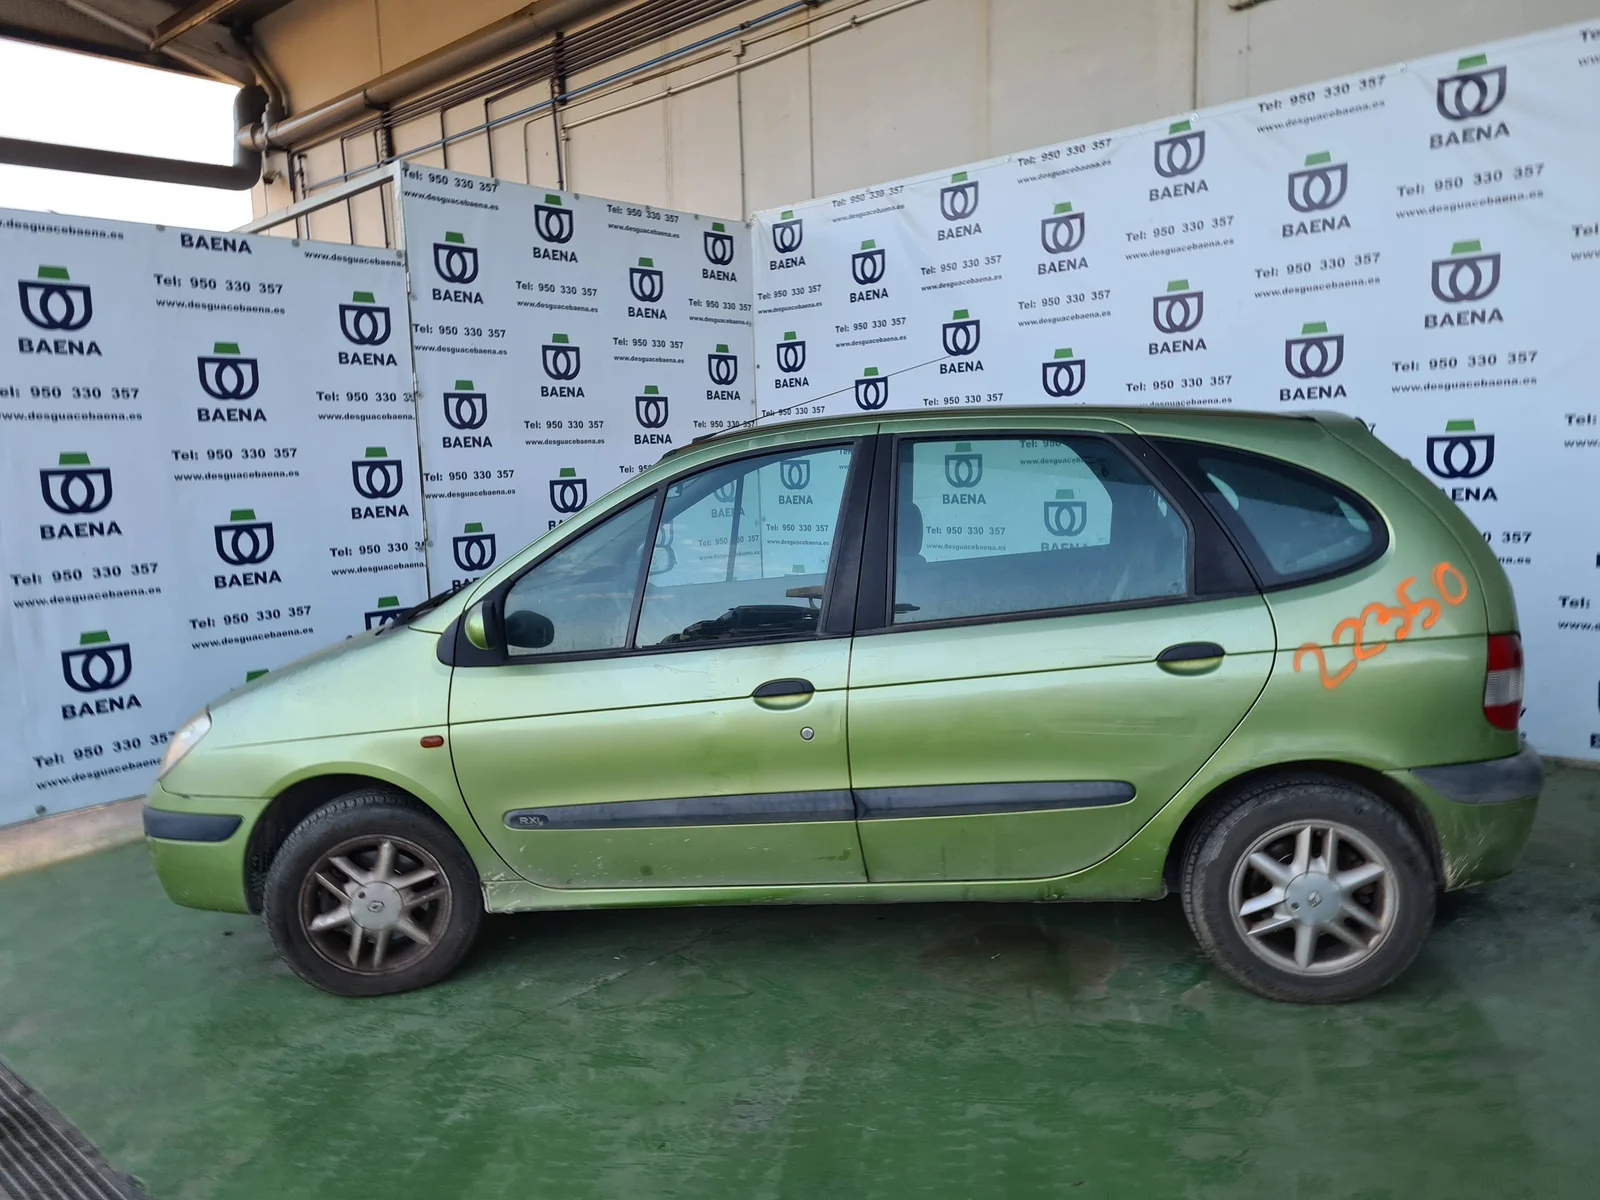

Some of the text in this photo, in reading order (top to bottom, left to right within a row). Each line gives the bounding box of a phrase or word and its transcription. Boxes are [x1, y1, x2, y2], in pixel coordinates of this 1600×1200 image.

[1430, 122, 1509, 149] BAENA
[402, 168, 498, 193] Tel: 950 330 357
[1150, 180, 1208, 201] BAENA
[607, 204, 679, 223] Tel: 950 330 357
[938, 223, 982, 241] BAENA
[1126, 216, 1233, 242] Tel: 950 330 357
[1282, 215, 1351, 238] BAENA
[180, 233, 252, 254] BAENA
[533, 247, 578, 263] BAENA
[770, 256, 806, 270] BAENA
[921, 255, 1001, 275] Tel: 950 330 357
[1038, 257, 1088, 275] BAENA
[1255, 253, 1380, 278] Tel: 950 330 357
[702, 268, 737, 282] BAENA
[154, 274, 283, 294] Tel: 950 330 357
[516, 281, 597, 296] Tel: 950 330 357
[921, 275, 1002, 291] www.desguacebaena.es
[432, 288, 484, 304] BAENA
[773, 290, 788, 298] 950
[792, 287, 805, 296] 330
[808, 284, 821, 293] 357
[850, 288, 889, 303] BAENA
[156, 300, 285, 314] www.desguacebaena.es
[517, 301, 598, 312] www.desguacebaena.es
[688, 298, 702, 306] Tel:
[706, 300, 719, 308] 950
[723, 302, 736, 310] 330
[1018, 290, 1110, 310] Tel: 950 330 357
[628, 307, 667, 320] BAENA
[758, 302, 822, 314] www.desguacebaena.es
[835, 317, 906, 333] Tel: 950 330 357
[1018, 311, 1111, 326] www.desguacebaena.es
[1425, 308, 1503, 329] BAENA
[412, 324, 506, 338] Tel: 950 330 357
[18, 337, 102, 356] BAENA
[613, 337, 628, 345] Tel:
[632, 338, 647, 347] 950
[652, 340, 666, 348] 330
[836, 336, 906, 347] www.desguacebaena.es
[1149, 338, 1207, 355] BAENA
[414, 345, 507, 356] www.desguacebaena.es
[338, 352, 398, 366] BAENA
[1392, 352, 1537, 372] Tel: 950 330 357
[940, 360, 984, 374] BAENA
[775, 377, 809, 389] BAENA
[1126, 376, 1232, 392] Tel: 950 330 357
[30, 386, 139, 399] 950 330 357
[316, 391, 396, 402] Tel: 950 330
[541, 386, 585, 397] BAENA
[707, 390, 741, 400] BAENA
[1280, 384, 1347, 401] BAENA
[923, 393, 1003, 406] Tel: 950 330 357
[197, 408, 267, 422] BAENA
[1565, 414, 1596, 425] Tel:
[524, 421, 541, 429] Tel:
[546, 421, 562, 429] 950
[568, 421, 583, 429] 330
[442, 436, 492, 448] BAENA
[525, 438, 605, 446] www.desguacebaena.es
[634, 434, 672, 444] BAENA
[172, 448, 297, 461] Tel: 950 330 357
[174, 470, 299, 481] www.desguacebaena.es
[423, 470, 514, 482] Tel: 950 330 357
[425, 489, 516, 499] www.desguacebaena.es
[779, 495, 813, 504] BAENA
[943, 494, 986, 504] BAENA
[351, 504, 409, 519] BAENA
[40, 521, 122, 540] BAENA
[990, 527, 1005, 535] 357
[1502, 532, 1531, 543] 357
[329, 542, 408, 557] Tel: 950 330
[10, 563, 158, 586] Tel: 950 330 357
[214, 570, 282, 589] BAENA
[13, 588, 161, 608] www.desguacebaena.es
[1559, 596, 1590, 609] Tel:
[189, 605, 311, 629] Tel: 950 330 357
[1293, 561, 1468, 689] 22350
[192, 628, 313, 649] www.desguacebaena.es
[61, 694, 142, 720] BAENA
[33, 738, 141, 768] Tel: 950 330
